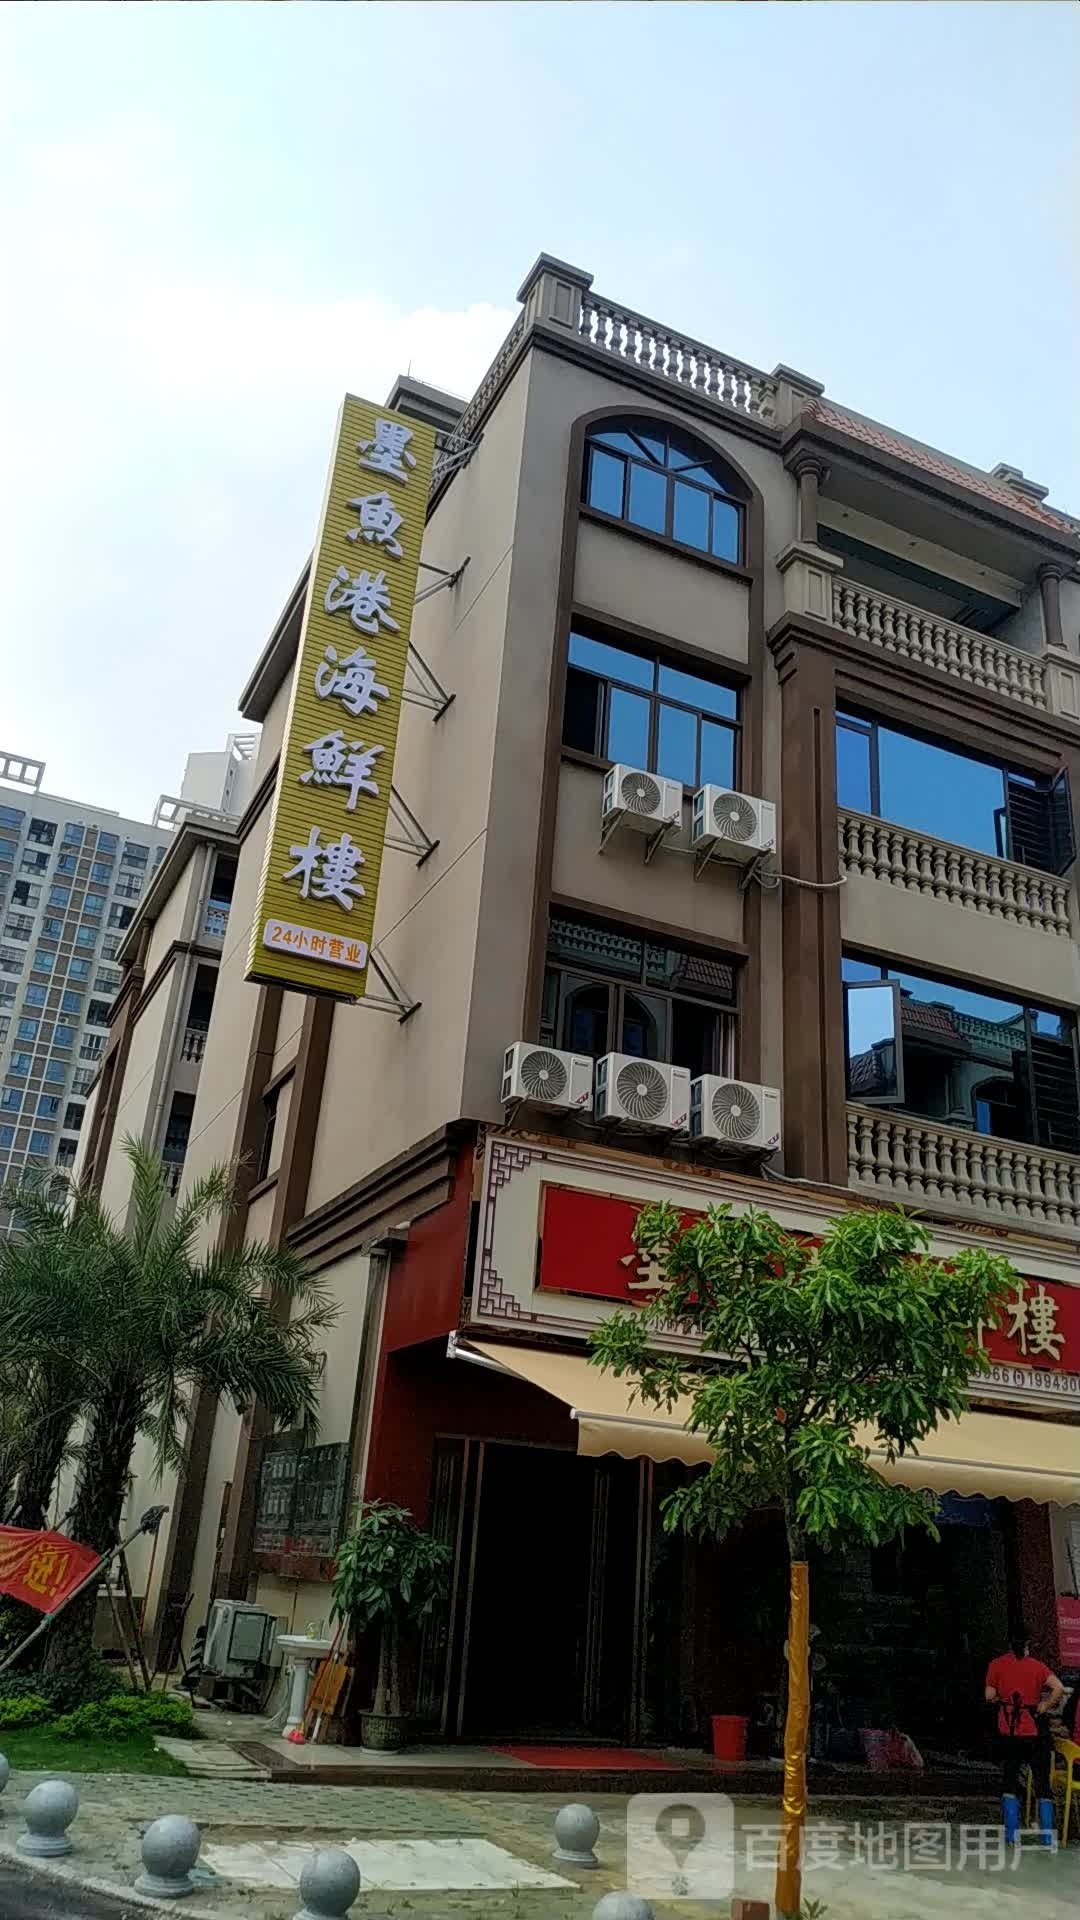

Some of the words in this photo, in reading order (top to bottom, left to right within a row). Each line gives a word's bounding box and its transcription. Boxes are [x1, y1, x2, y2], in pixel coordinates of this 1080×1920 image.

[283, 417, 417, 913] 墨魚港海鮮樓
[271, 926, 362, 964] 24小时营业
[1028, 1371, 1080, 1392] 199430
